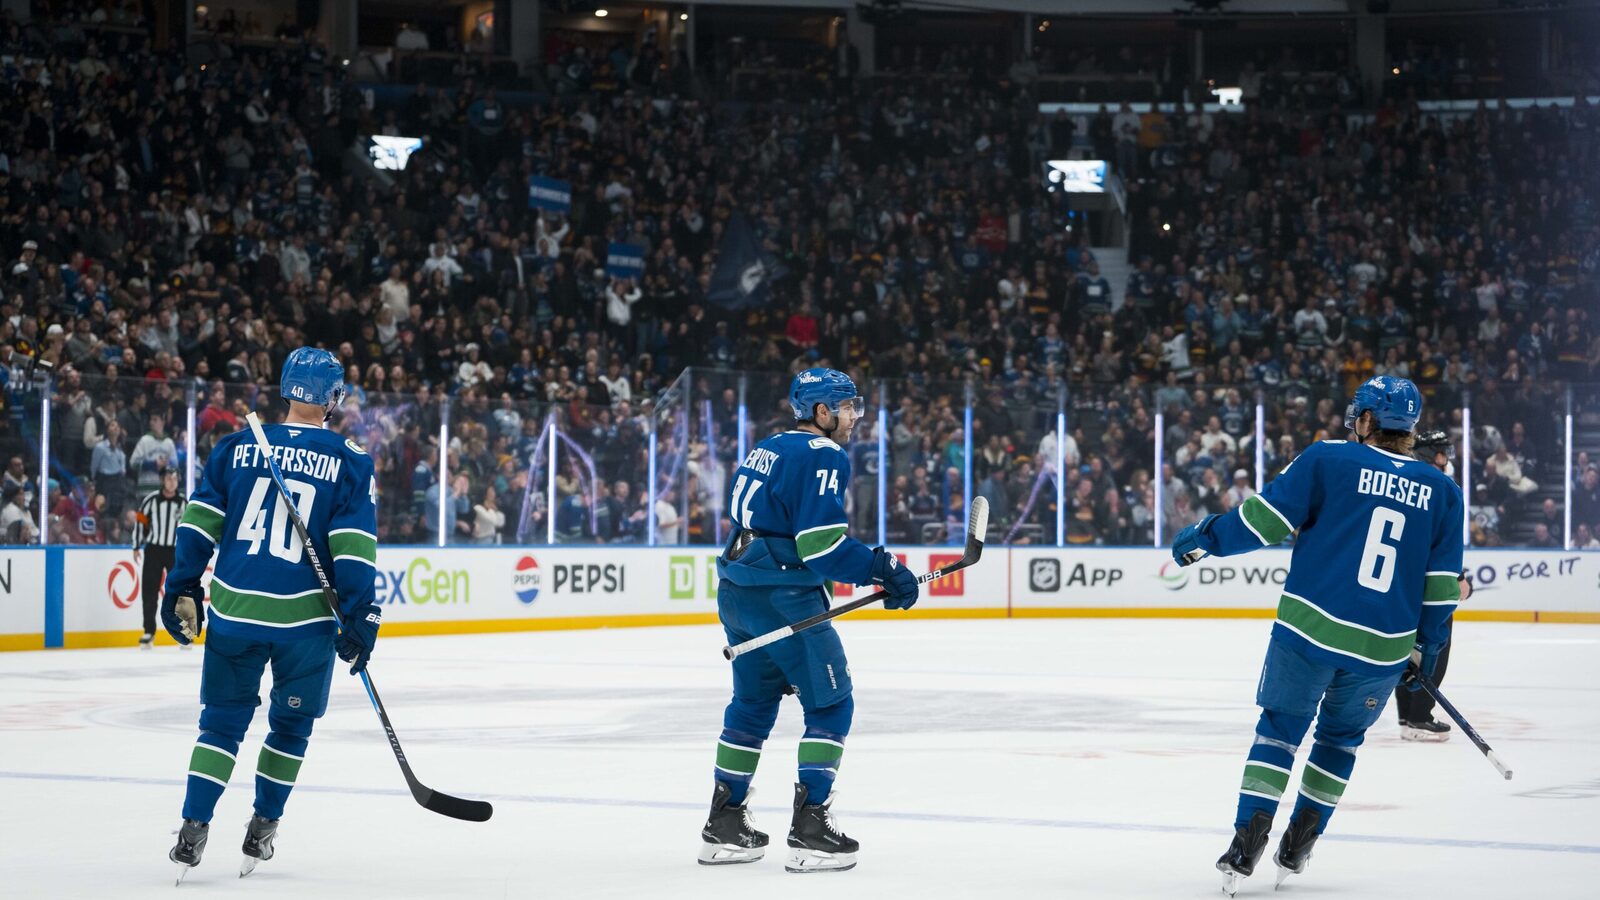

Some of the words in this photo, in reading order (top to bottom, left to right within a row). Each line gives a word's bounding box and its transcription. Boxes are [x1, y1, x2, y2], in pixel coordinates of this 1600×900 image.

[291, 385, 303, 398] 40
[1408, 400, 1413, 411] 6
[816, 469, 839, 496] 74
[1357, 468, 1432, 511] BOESER
[236, 477, 316, 564] 40
[1357, 506, 1406, 593] 6
[374, 557, 470, 605] exGen
[553, 564, 625, 593] PEPSI
[1199, 567, 1236, 585] DP
[1507, 562, 1550, 581] FOR
[1559, 556, 1581, 576] IT
